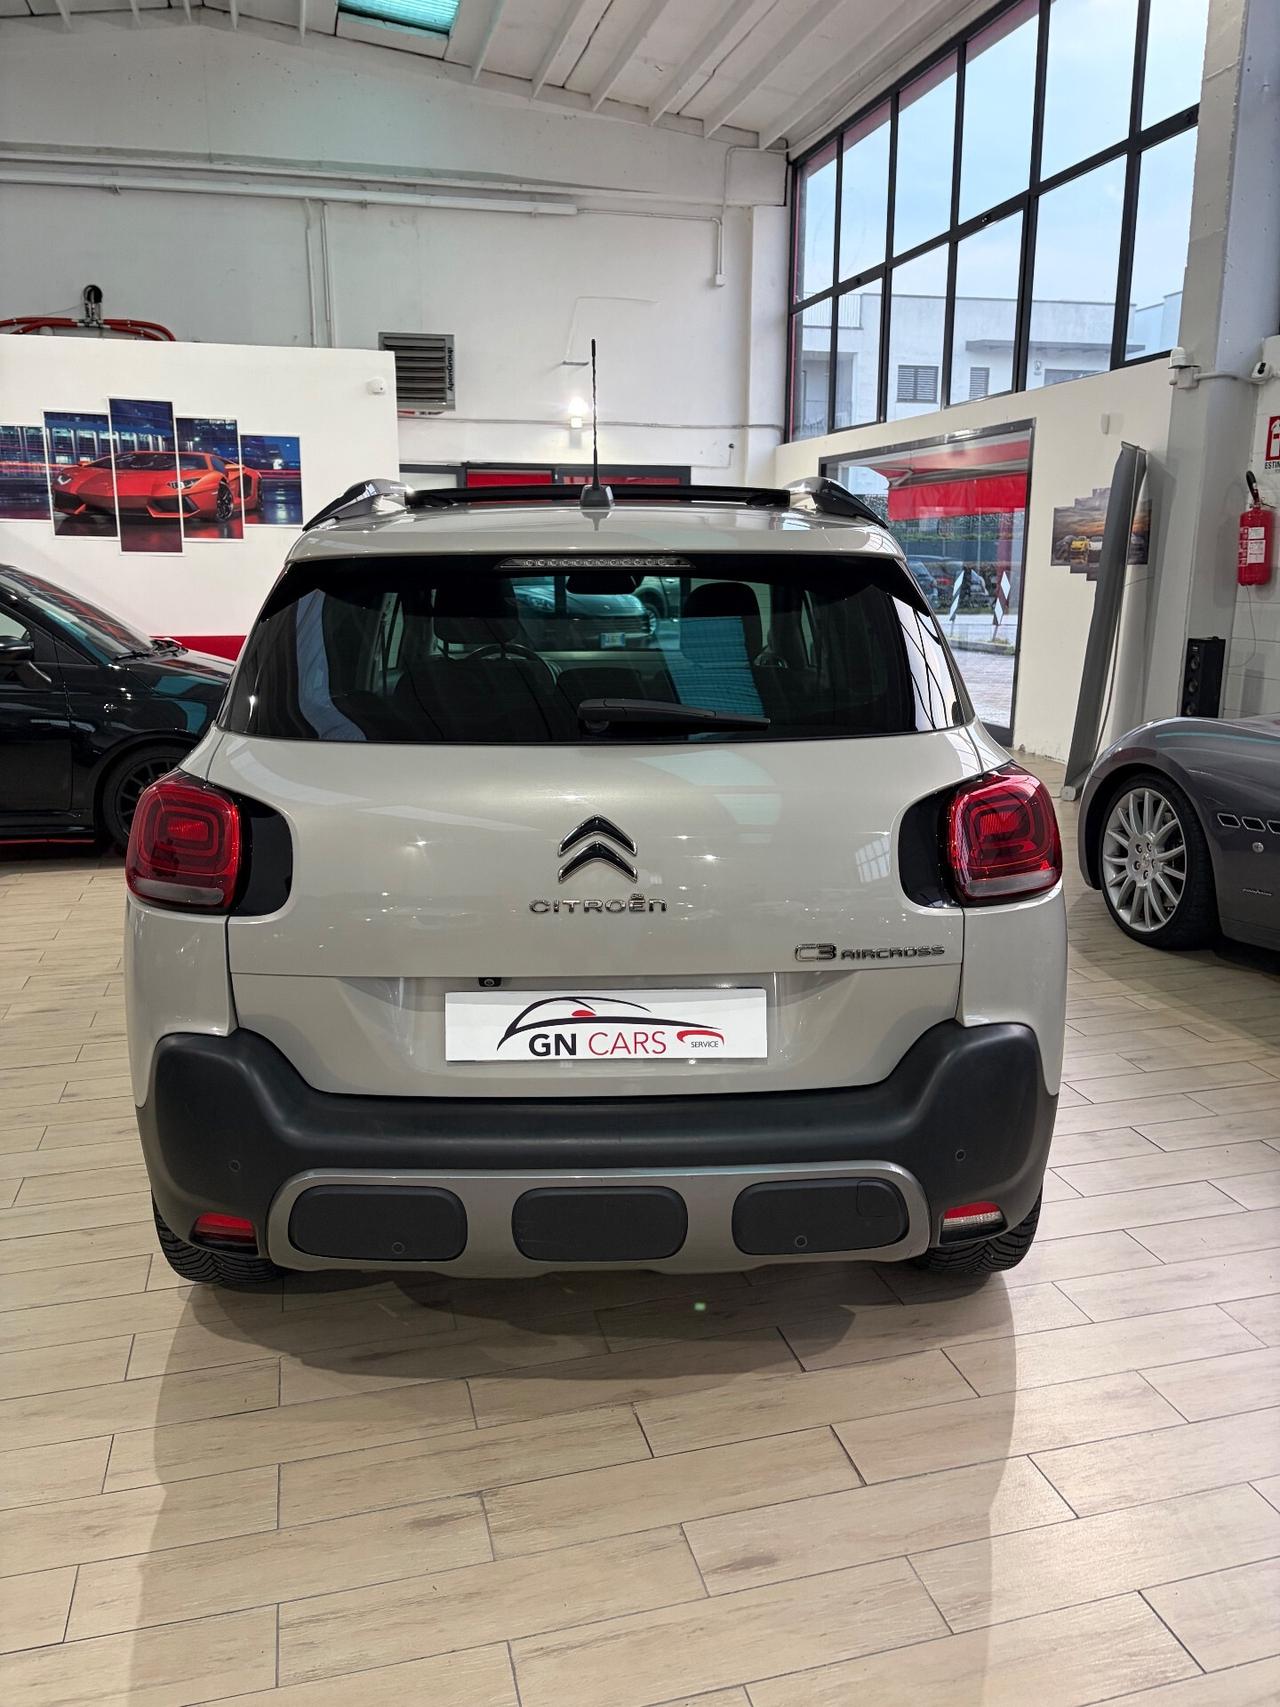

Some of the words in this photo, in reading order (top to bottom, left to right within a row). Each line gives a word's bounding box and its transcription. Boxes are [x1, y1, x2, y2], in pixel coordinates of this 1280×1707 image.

[794, 943, 837, 963] C3
[840, 944, 946, 960] AIRCROSS
[528, 1033, 577, 1057] GN
[588, 1031, 667, 1056] CARS
[690, 1040, 719, 1049] SERVICE
